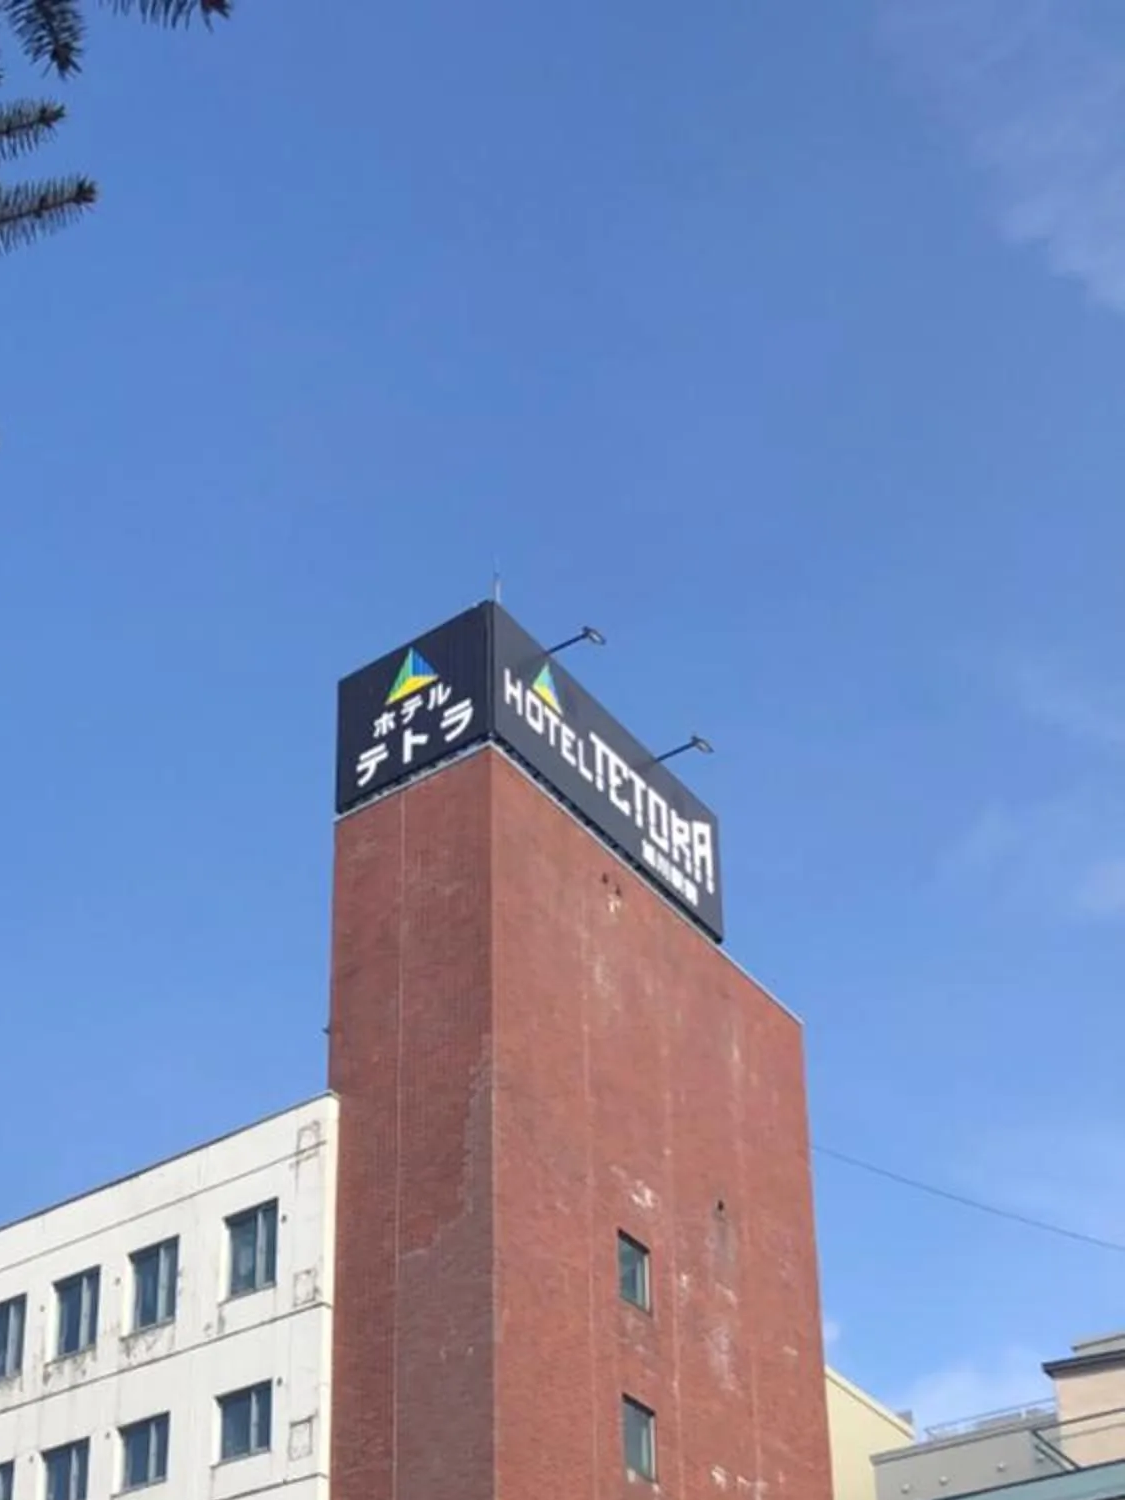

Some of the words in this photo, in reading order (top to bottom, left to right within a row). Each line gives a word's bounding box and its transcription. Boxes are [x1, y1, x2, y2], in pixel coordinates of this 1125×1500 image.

[355, 698, 474, 787] テトラ
[373, 682, 452, 738] ホテル
[503, 668, 593, 787] HOTEL
[589, 730, 715, 895] TETORA
